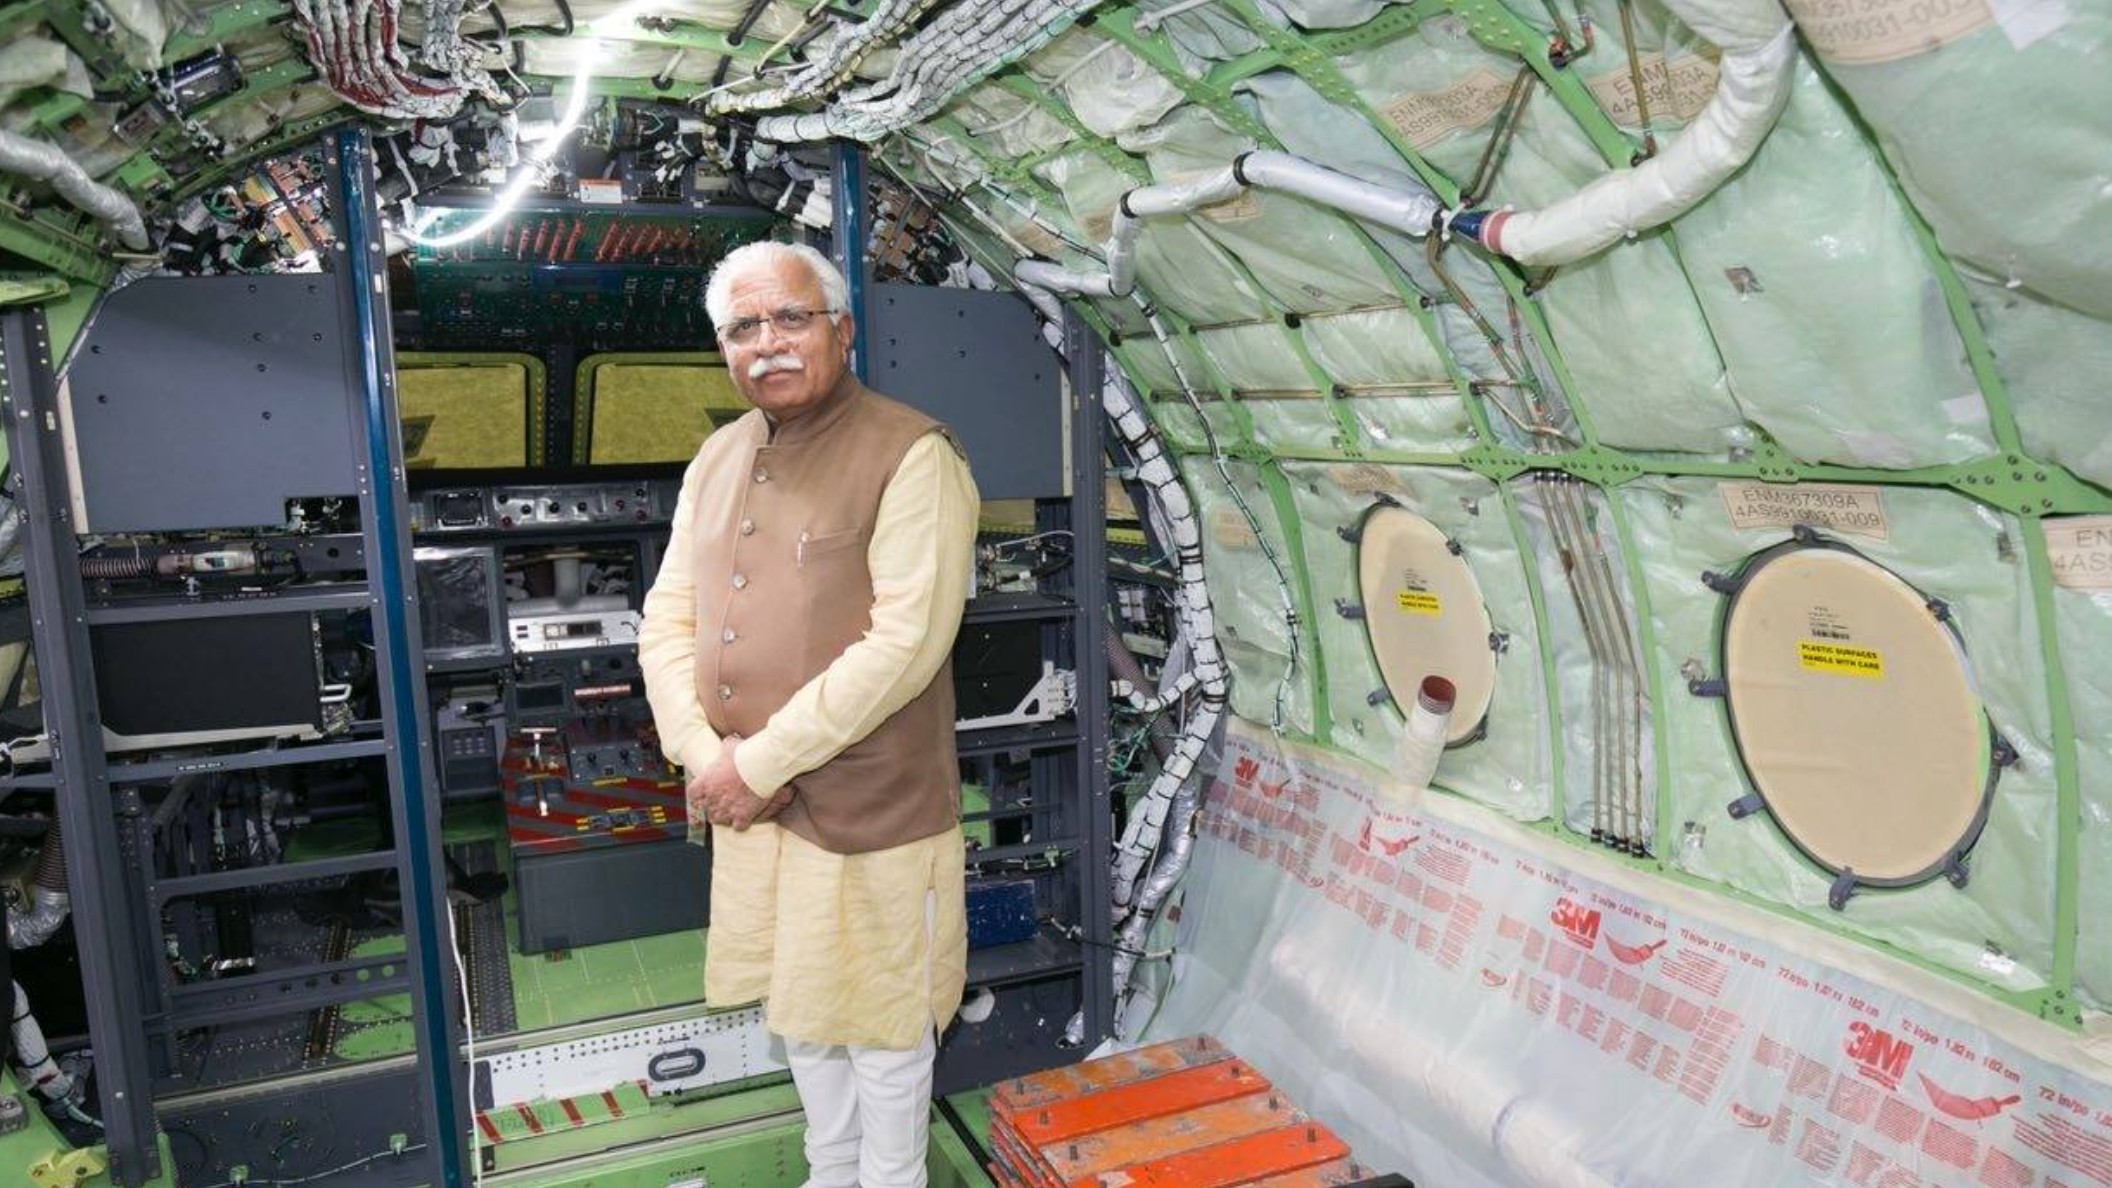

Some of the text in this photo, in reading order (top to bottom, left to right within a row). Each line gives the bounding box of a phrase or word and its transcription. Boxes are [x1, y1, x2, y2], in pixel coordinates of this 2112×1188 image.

[2076, 529, 2112, 548] EN
[2054, 551, 2112, 573] 4AS
[1551, 897, 1601, 939] 3M
[1845, 1020, 1915, 1080] 3M
[2038, 1085, 2056, 1102] 72
